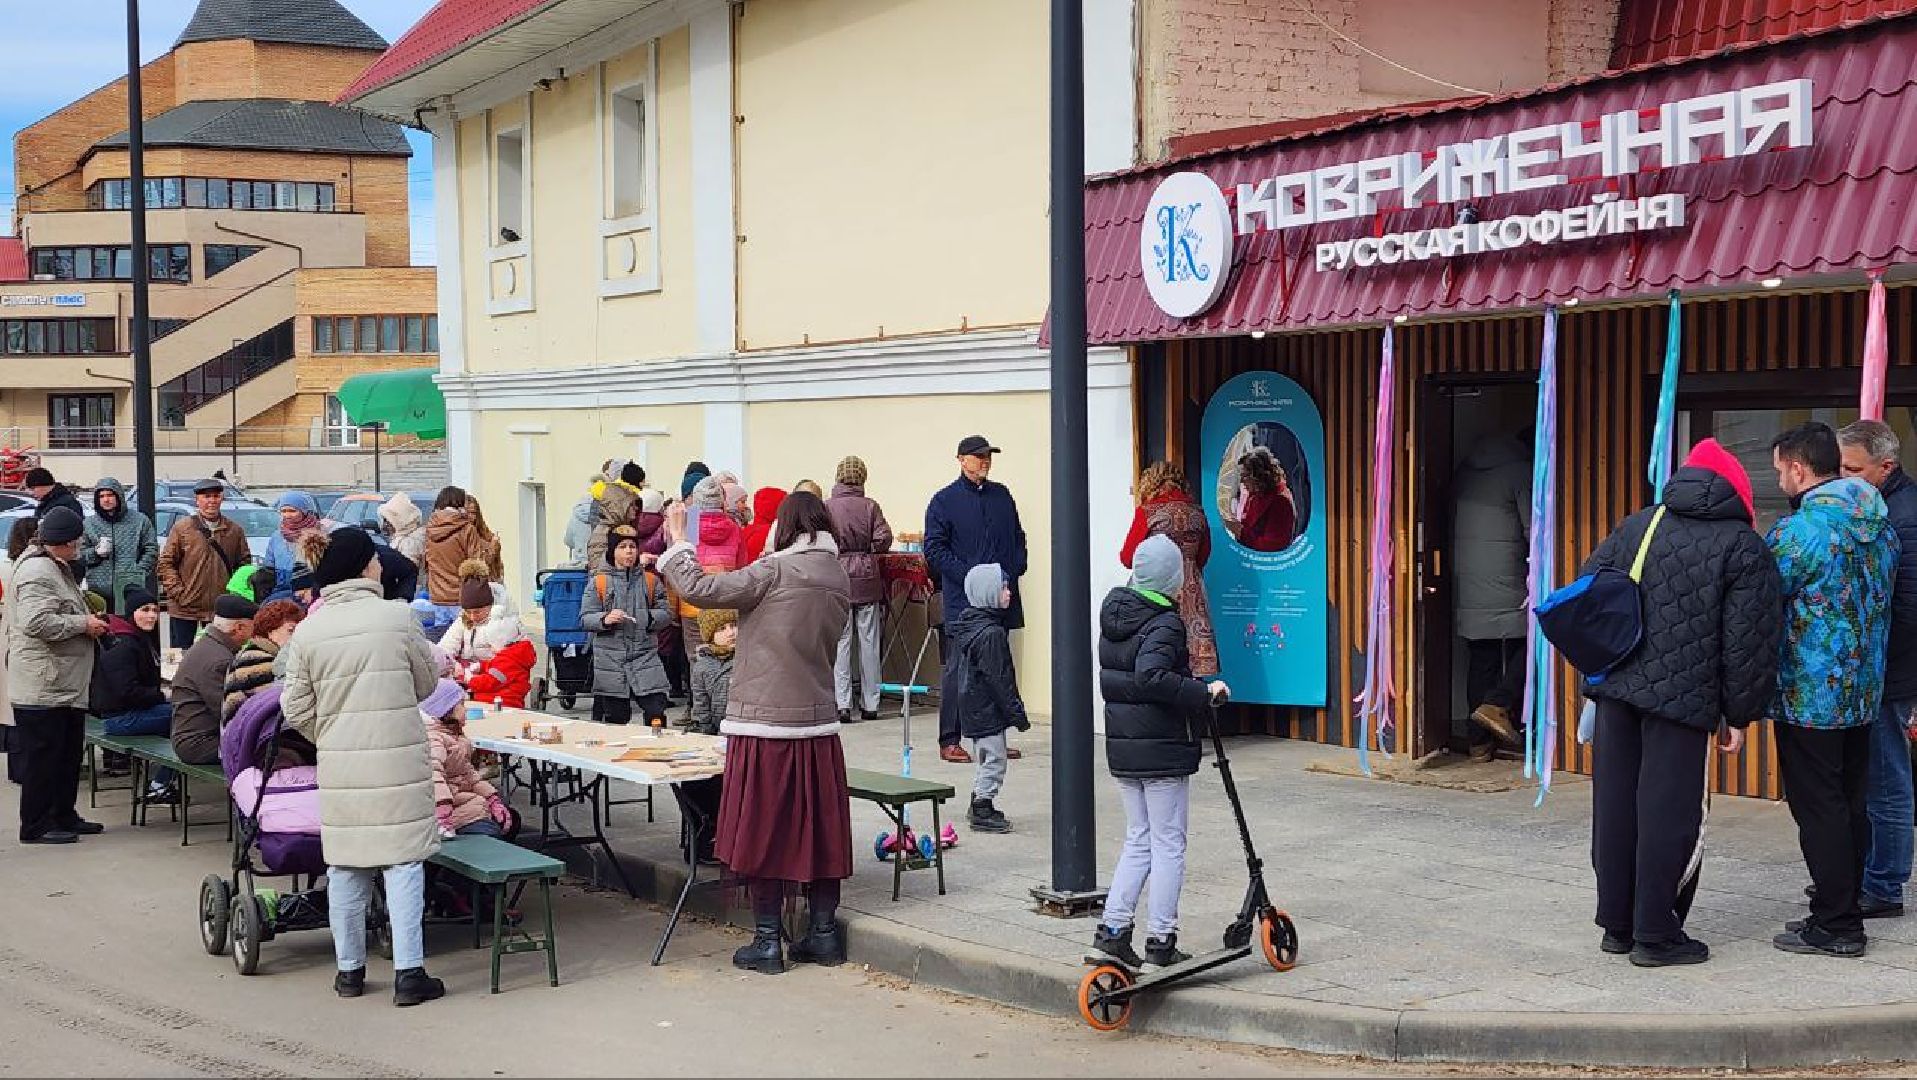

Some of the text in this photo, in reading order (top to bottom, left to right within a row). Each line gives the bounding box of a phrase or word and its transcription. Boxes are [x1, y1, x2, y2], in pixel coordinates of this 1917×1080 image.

[1237, 79, 1812, 235] КОВРИЖЕЧНАЯ
[1316, 193, 1684, 272] РУССКАЯ КОФЕЙНЯ
